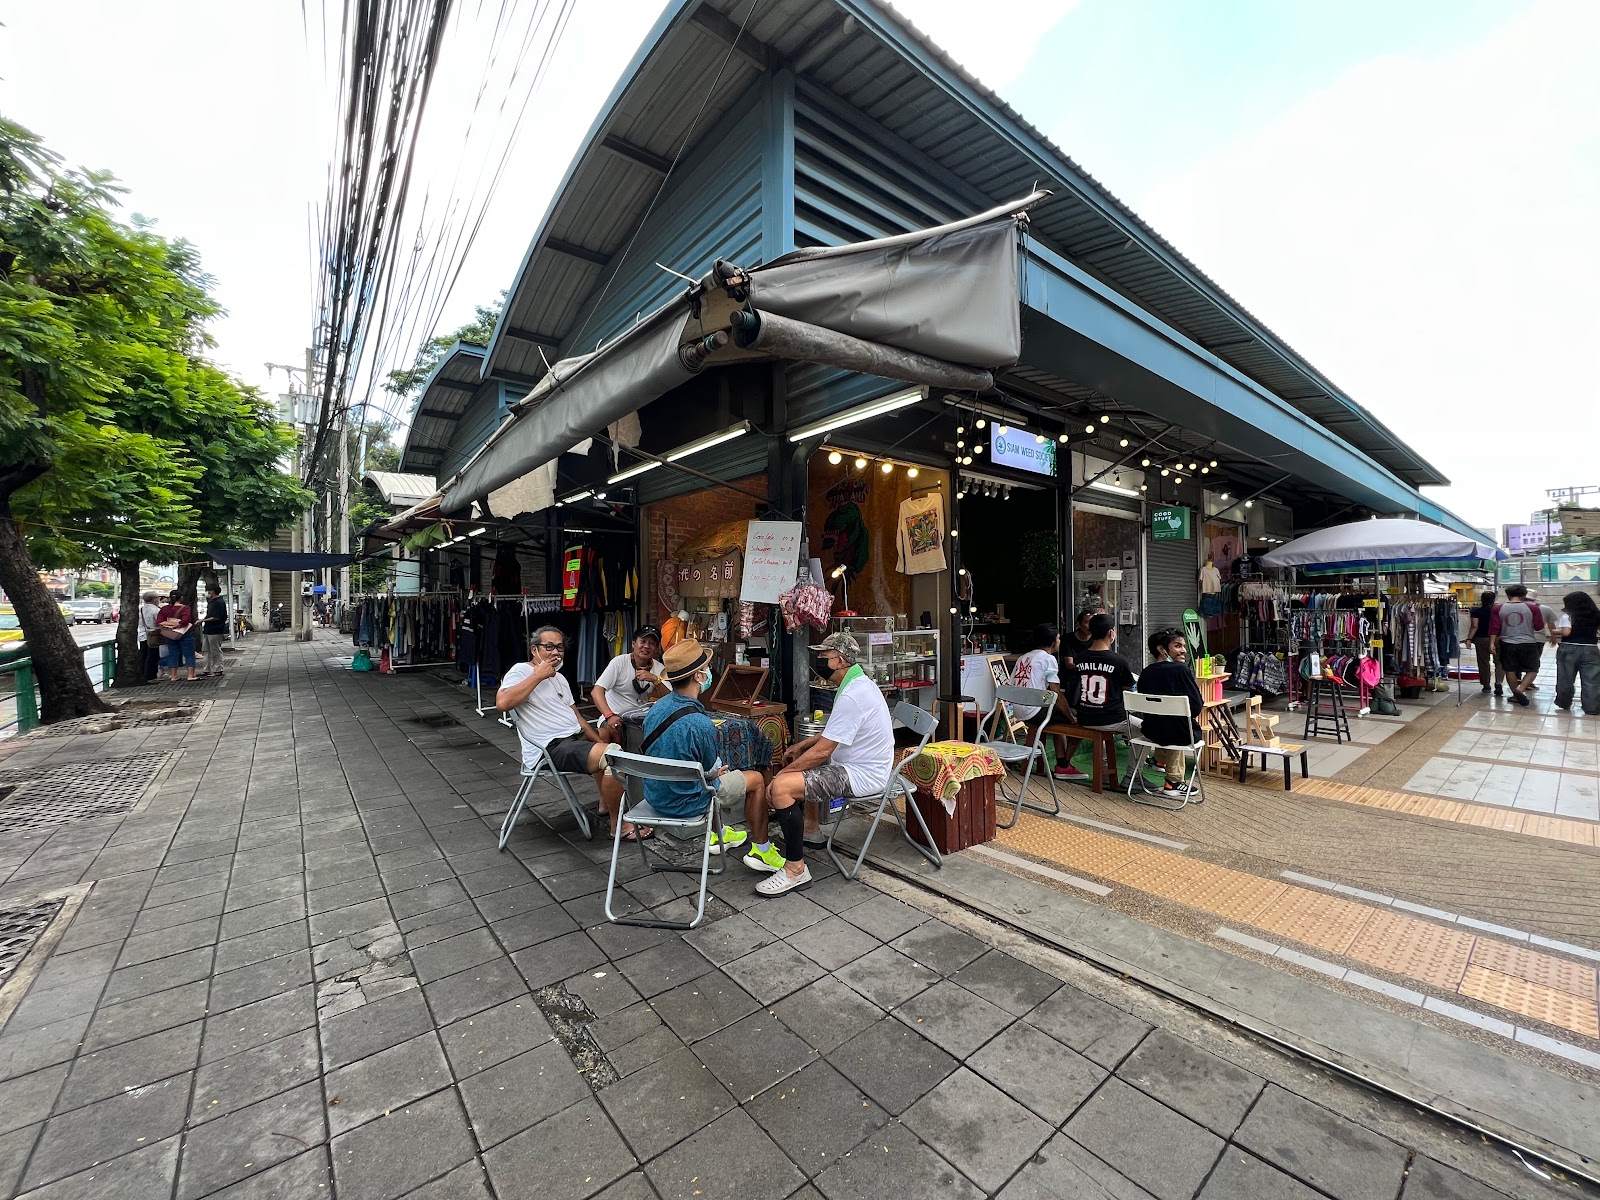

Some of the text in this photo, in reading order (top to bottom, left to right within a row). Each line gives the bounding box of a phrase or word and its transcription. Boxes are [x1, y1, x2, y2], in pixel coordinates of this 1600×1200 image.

[1006, 442, 1020, 455] SIAM
[1020, 446, 1035, 459] WEED
[1076, 662, 1115, 673] THAILAND
[1080, 674, 1107, 705] 10
